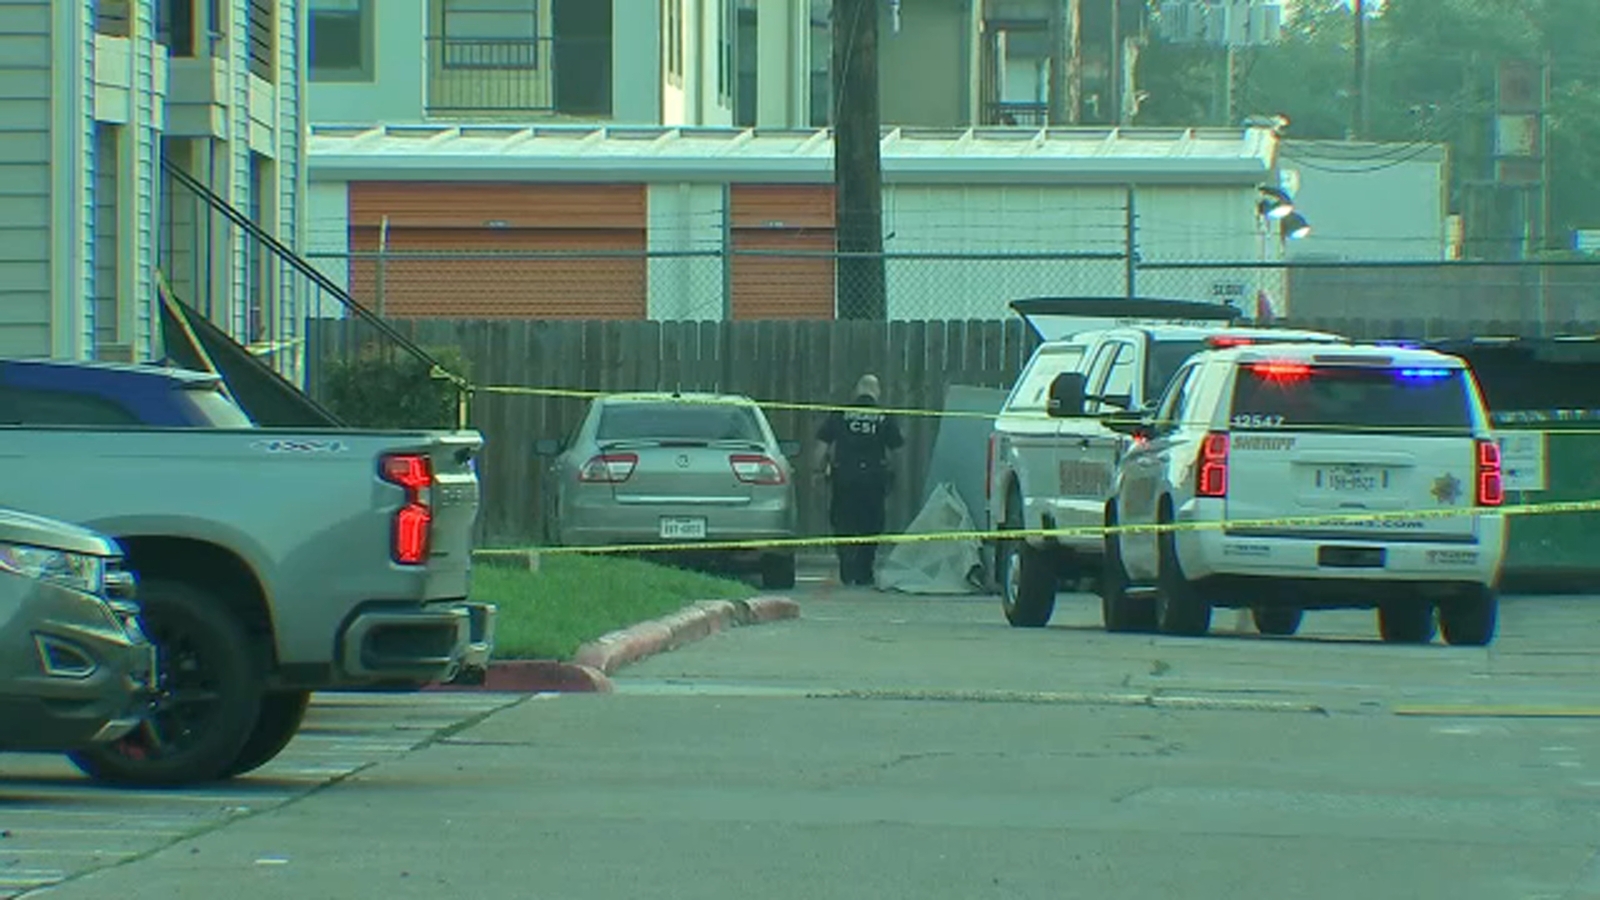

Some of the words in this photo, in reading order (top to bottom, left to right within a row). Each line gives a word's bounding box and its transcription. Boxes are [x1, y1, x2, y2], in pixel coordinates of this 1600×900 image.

[1233, 414, 1286, 427] 12547
[849, 421, 876, 435] CSI
[1234, 435, 1296, 451] SHERIFF
